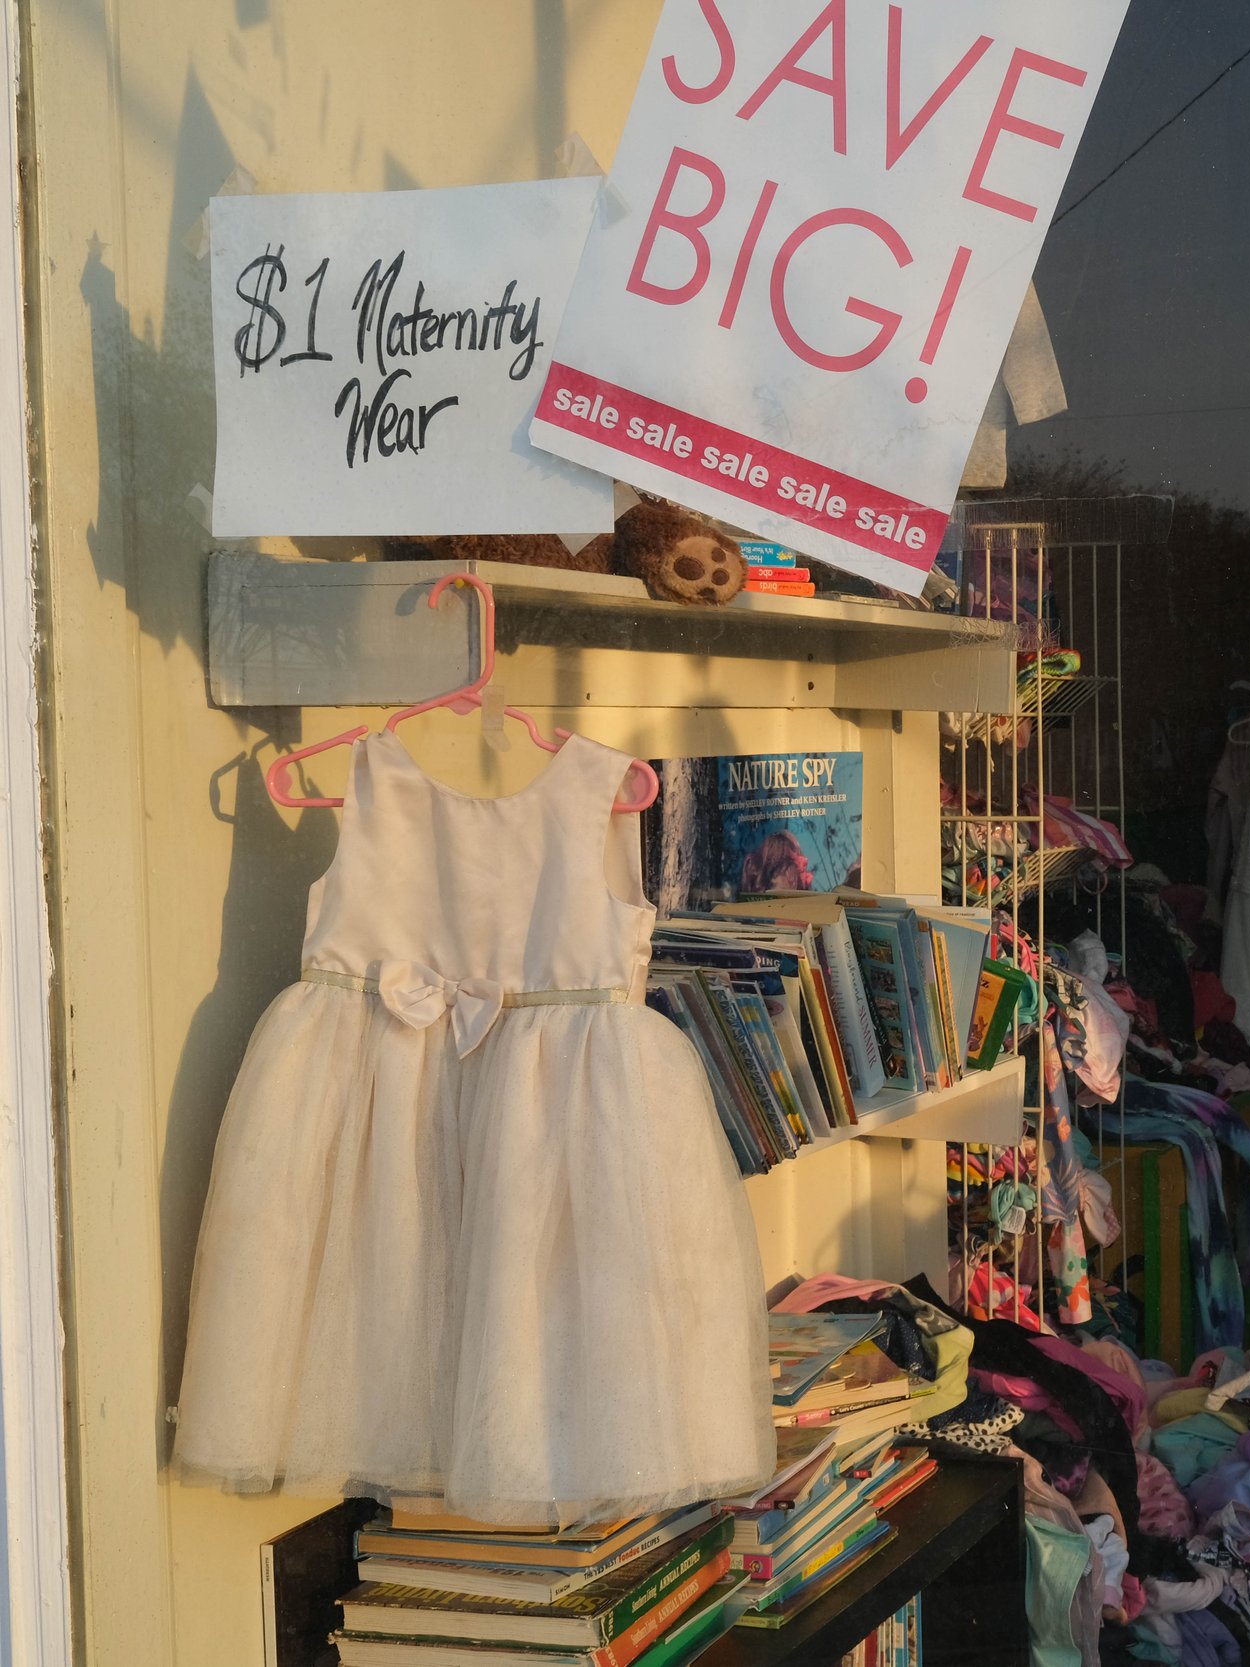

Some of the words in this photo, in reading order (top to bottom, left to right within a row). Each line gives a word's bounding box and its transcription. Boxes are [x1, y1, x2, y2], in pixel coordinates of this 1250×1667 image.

[661, 0, 1088, 223] SAVE
[625, 145, 973, 404] BIG!
[235, 243, 332, 377] $1
[352, 250, 543, 380] Maternity
[335, 369, 459, 468] Wear
[554, 385, 619, 429] sale
[626, 414, 694, 459] sale
[700, 443, 769, 489] sale
[777, 472, 847, 518] sale
[855, 503, 927, 550] sale
[758, 569, 773, 579] abc
[760, 582, 778, 592] birds
[728, 759, 799, 792] NATURE
[802, 758, 837, 788] SPY
[791, 796, 802, 805] and
[803, 795, 818, 805] KEN
[818, 794, 847, 804] KREISLER
[773, 809, 800, 819] SHELLEY
[801, 808, 826, 817] ROTNER
[859, 1005, 877, 1070] SUMMER
[555, 1583, 571, 1596] SIMON
[583, 1569, 594, 1580] THE
[618, 1547, 640, 1563] Fondue
[640, 1536, 660, 1551] RECIPES
[659, 1567, 681, 1592] ANNUAL
[679, 1550, 701, 1576] RECIPES
[658, 1597, 679, 1622] ANNUAL
[678, 1578, 700, 1604] RECIPES
